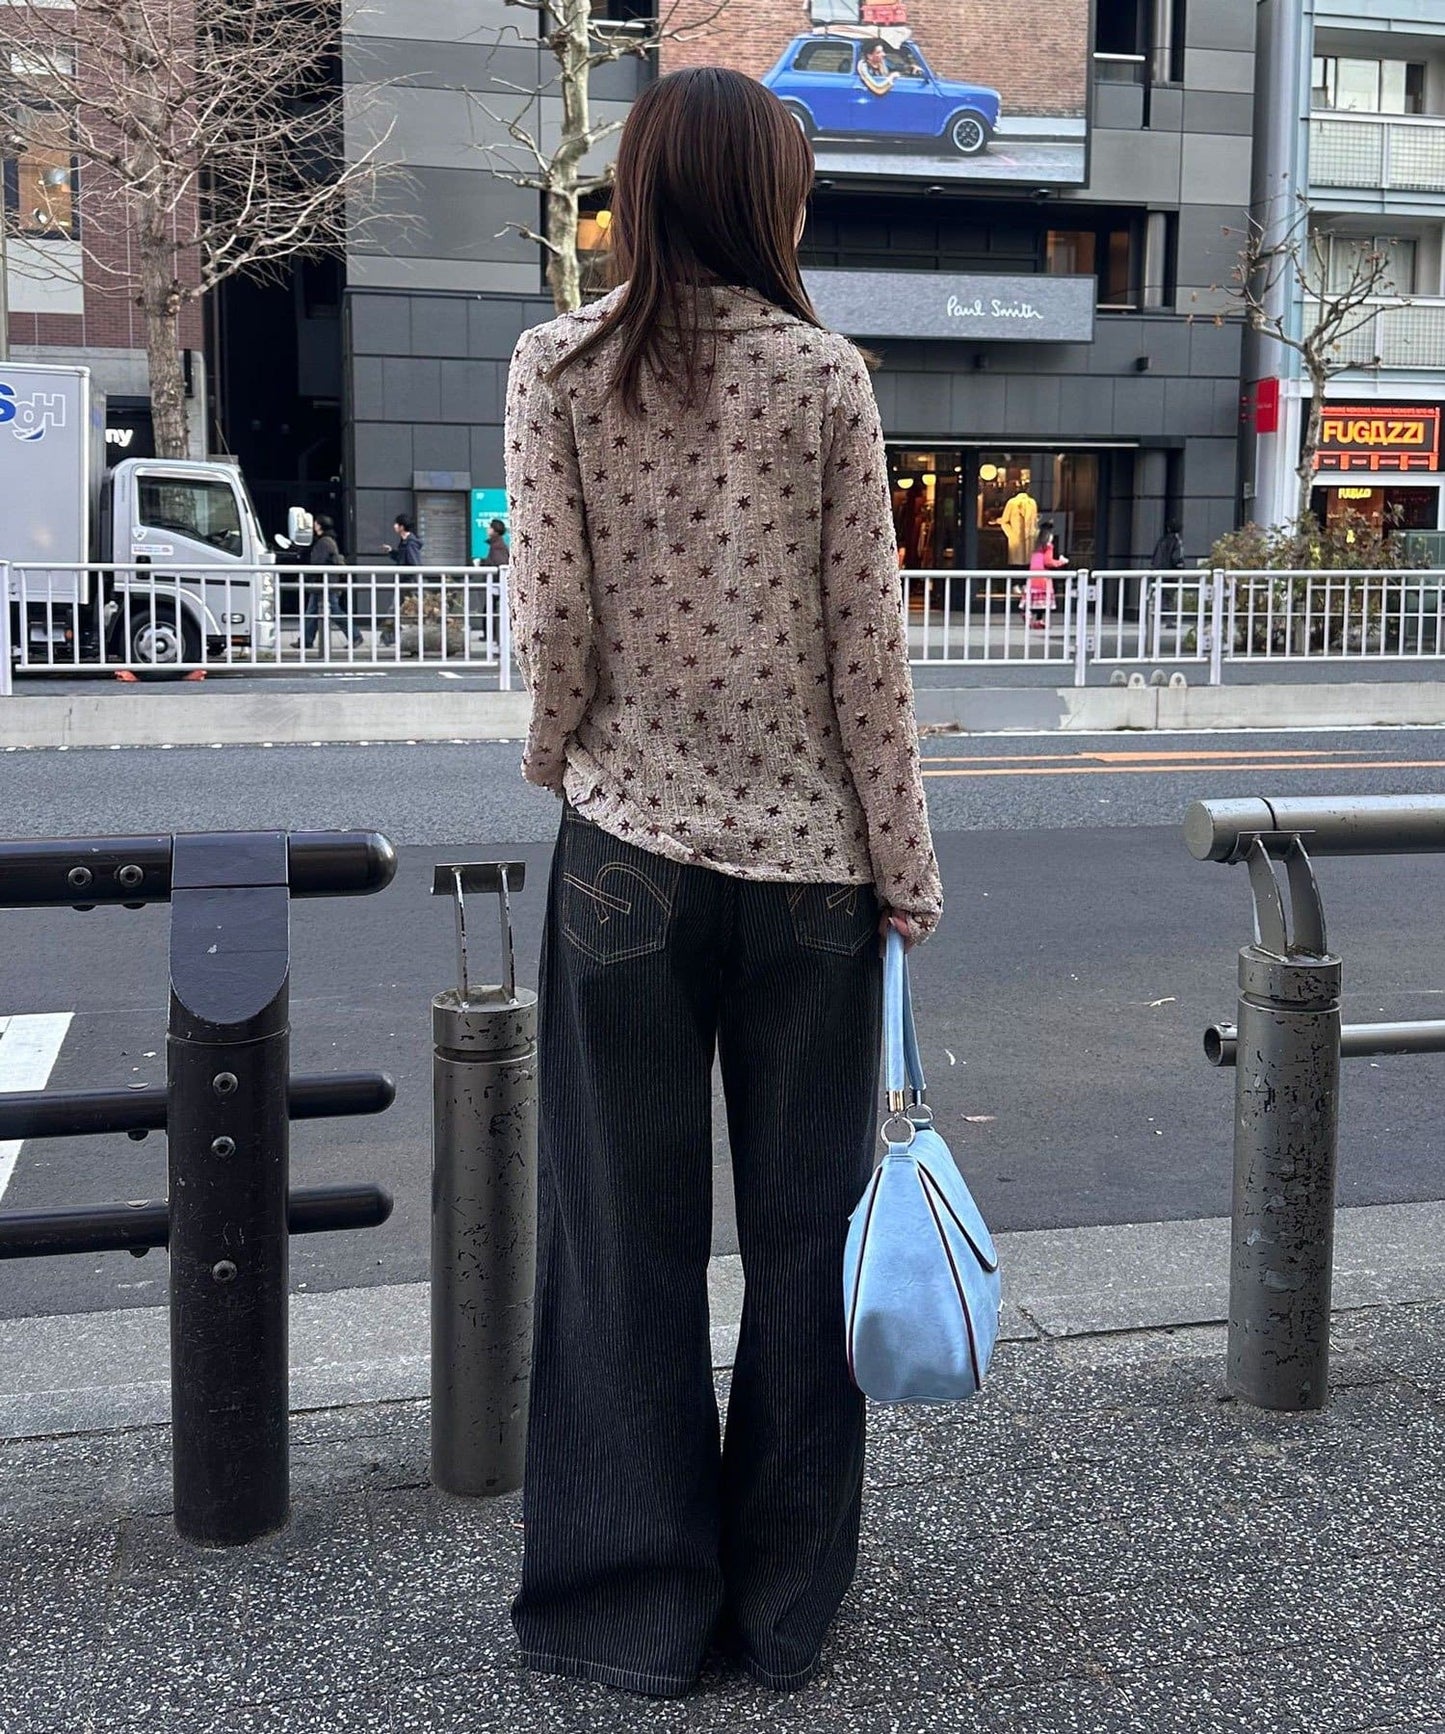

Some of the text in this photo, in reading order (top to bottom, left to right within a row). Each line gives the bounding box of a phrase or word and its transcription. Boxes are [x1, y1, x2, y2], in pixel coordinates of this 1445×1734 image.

[946, 295, 1044, 319] Paul Smith
[105, 428, 133, 447] ny
[1323, 420, 1425, 446] FUGAZZI
